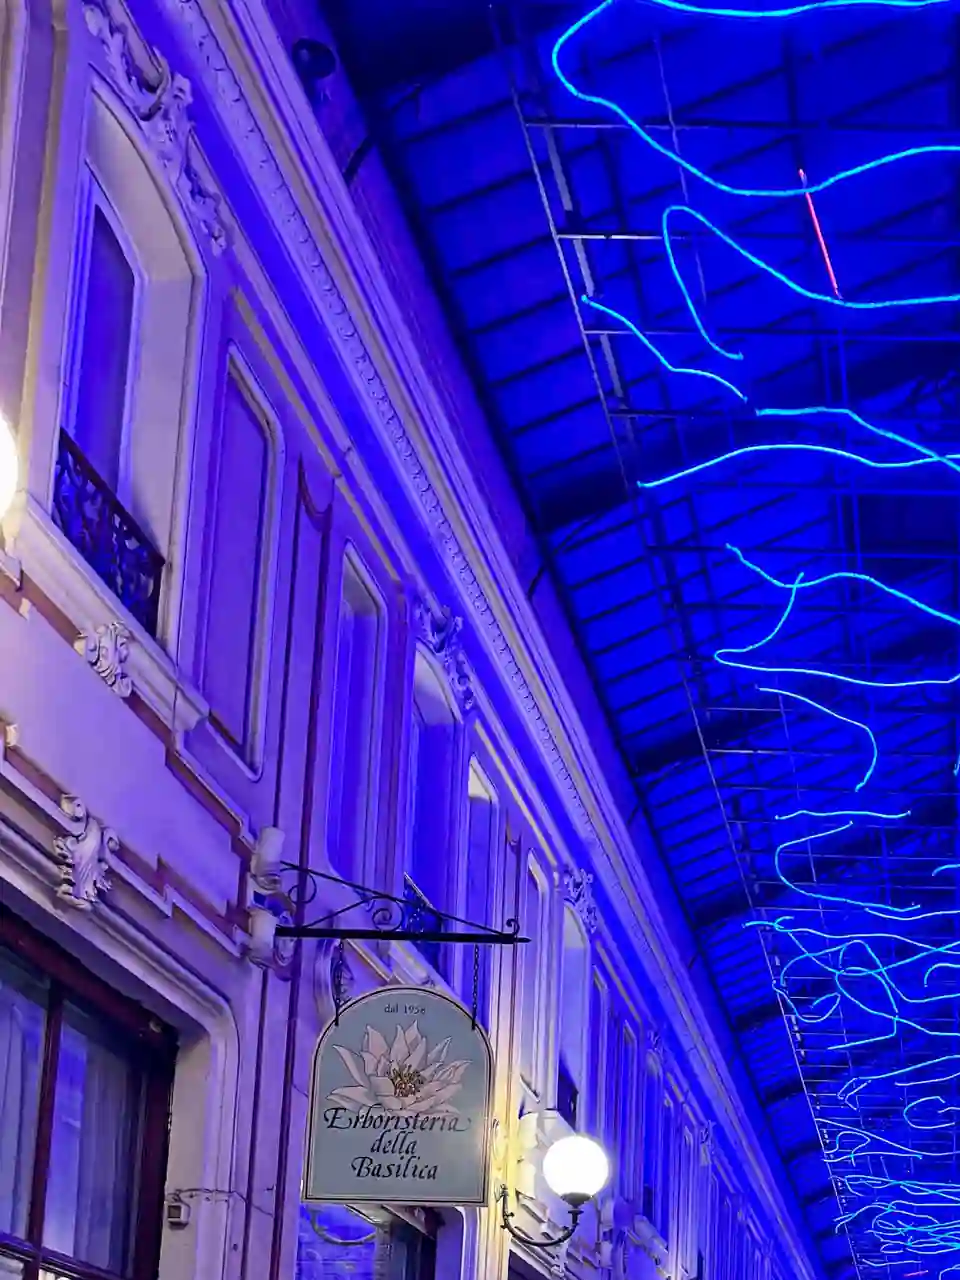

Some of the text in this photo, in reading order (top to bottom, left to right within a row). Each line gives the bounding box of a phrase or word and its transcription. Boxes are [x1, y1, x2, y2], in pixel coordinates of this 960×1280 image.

[323, 1103, 472, 1132] Erboristeria
[370, 1129, 418, 1155] della
[350, 1156, 439, 1180] Basilica
